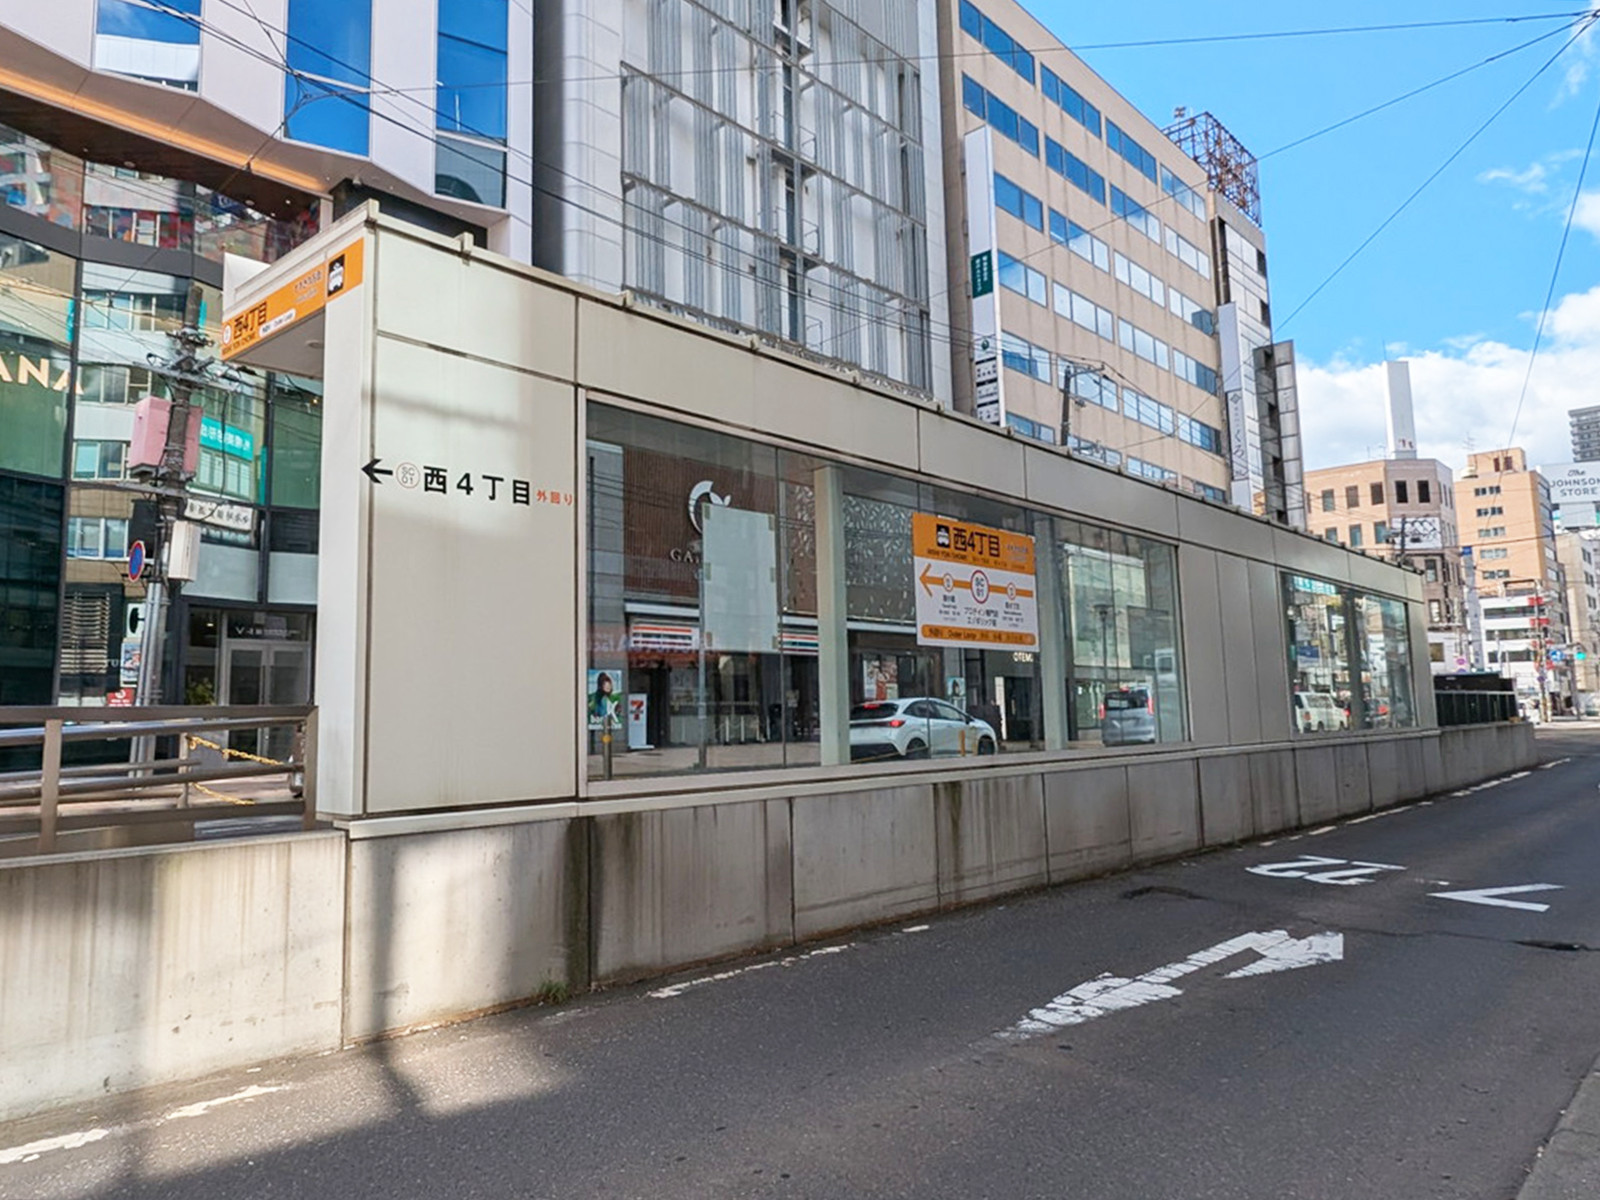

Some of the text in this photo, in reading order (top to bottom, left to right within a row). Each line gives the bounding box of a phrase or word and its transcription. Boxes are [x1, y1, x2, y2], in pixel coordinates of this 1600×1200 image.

[423, 465, 531, 507] 西4丁目
[1560, 486, 1598, 497] STORE
[952, 527, 1000, 557] 西4丁目
